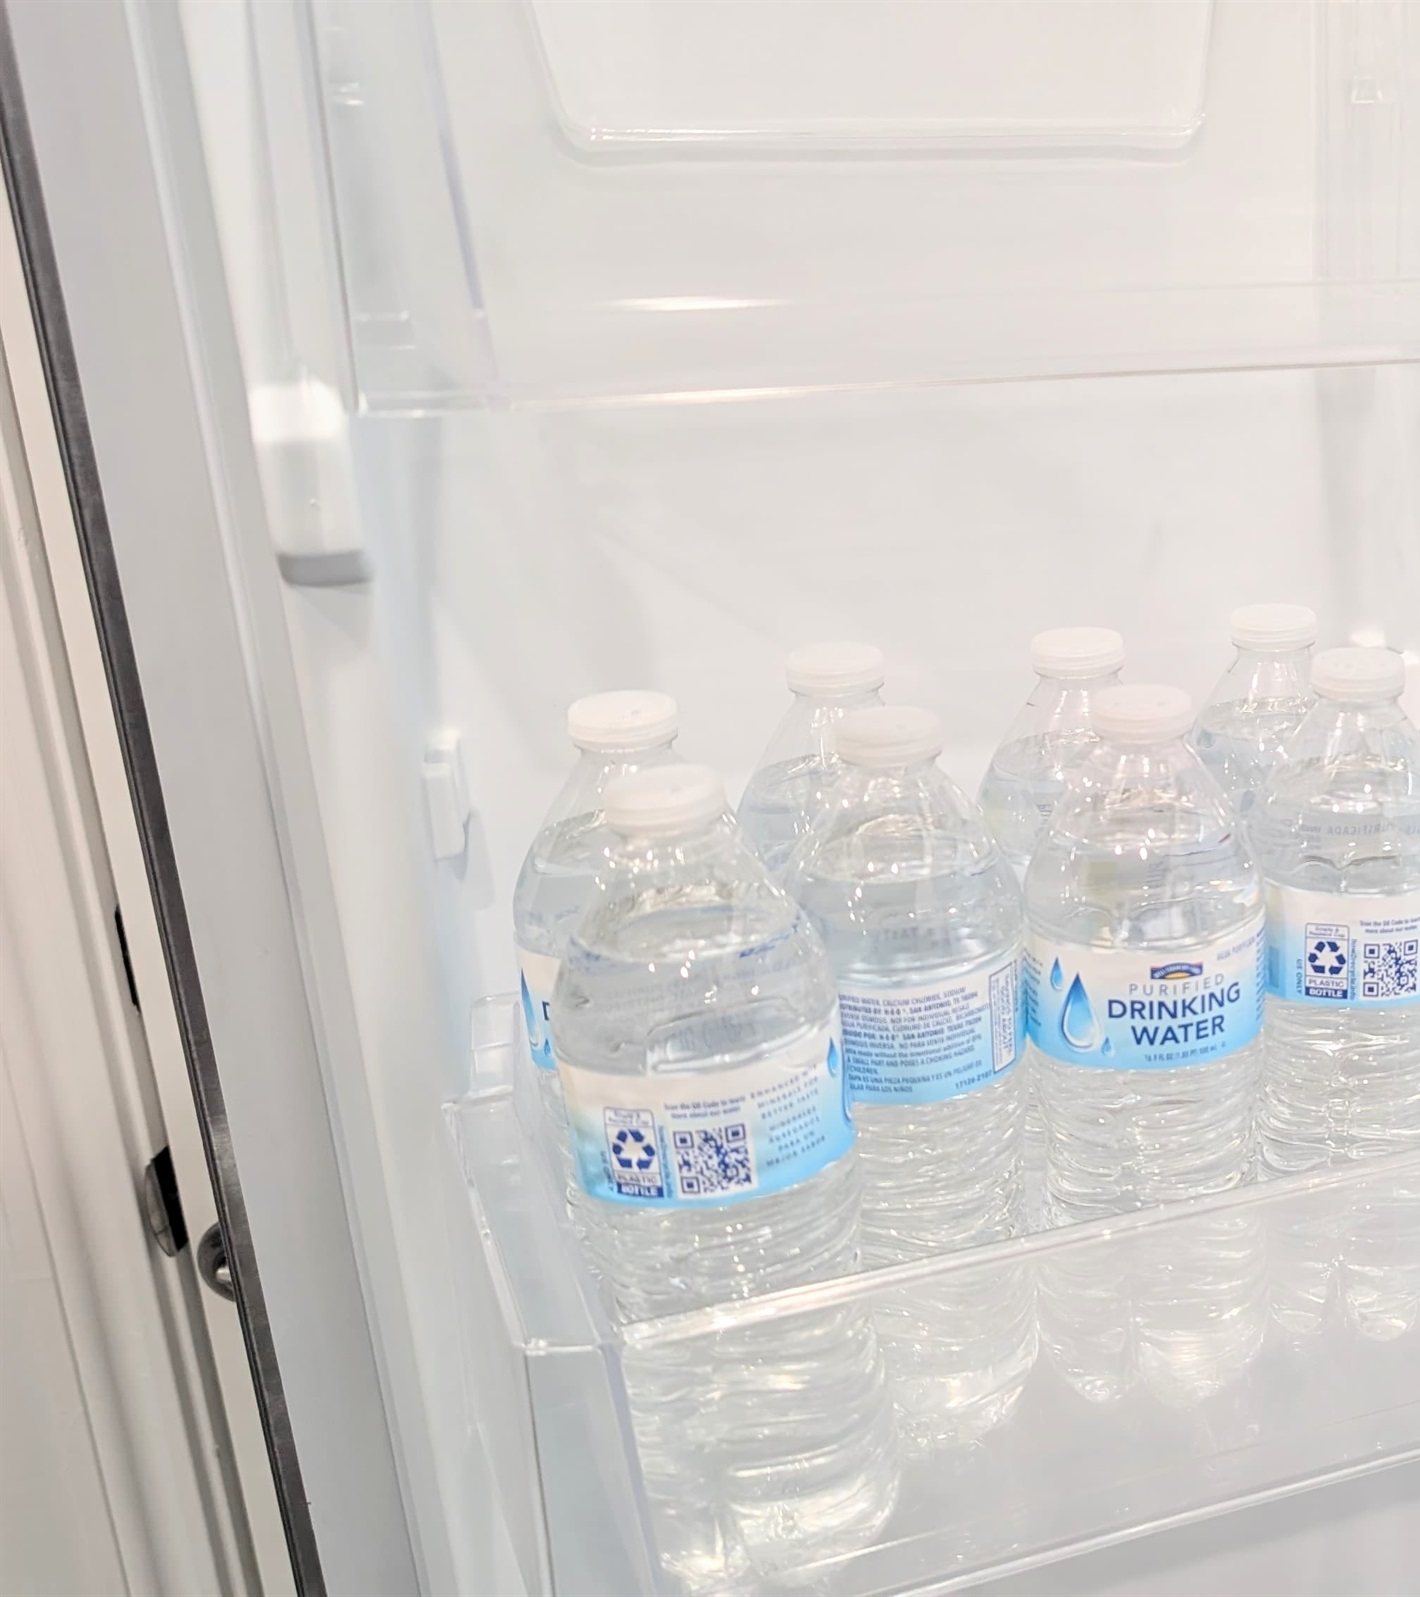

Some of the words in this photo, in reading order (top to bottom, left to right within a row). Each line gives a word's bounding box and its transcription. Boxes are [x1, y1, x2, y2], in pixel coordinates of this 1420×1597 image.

[1129, 972, 1226, 996] PURIFIED
[1308, 978, 1345, 988] PLASTIC
[1309, 987, 1344, 998] BOTTLE
[1108, 981, 1241, 1020] DRINKING
[1130, 1015, 1226, 1047] WATER
[617, 1172, 657, 1184] PLASTIC
[621, 1184, 658, 1197] BOTTLE
